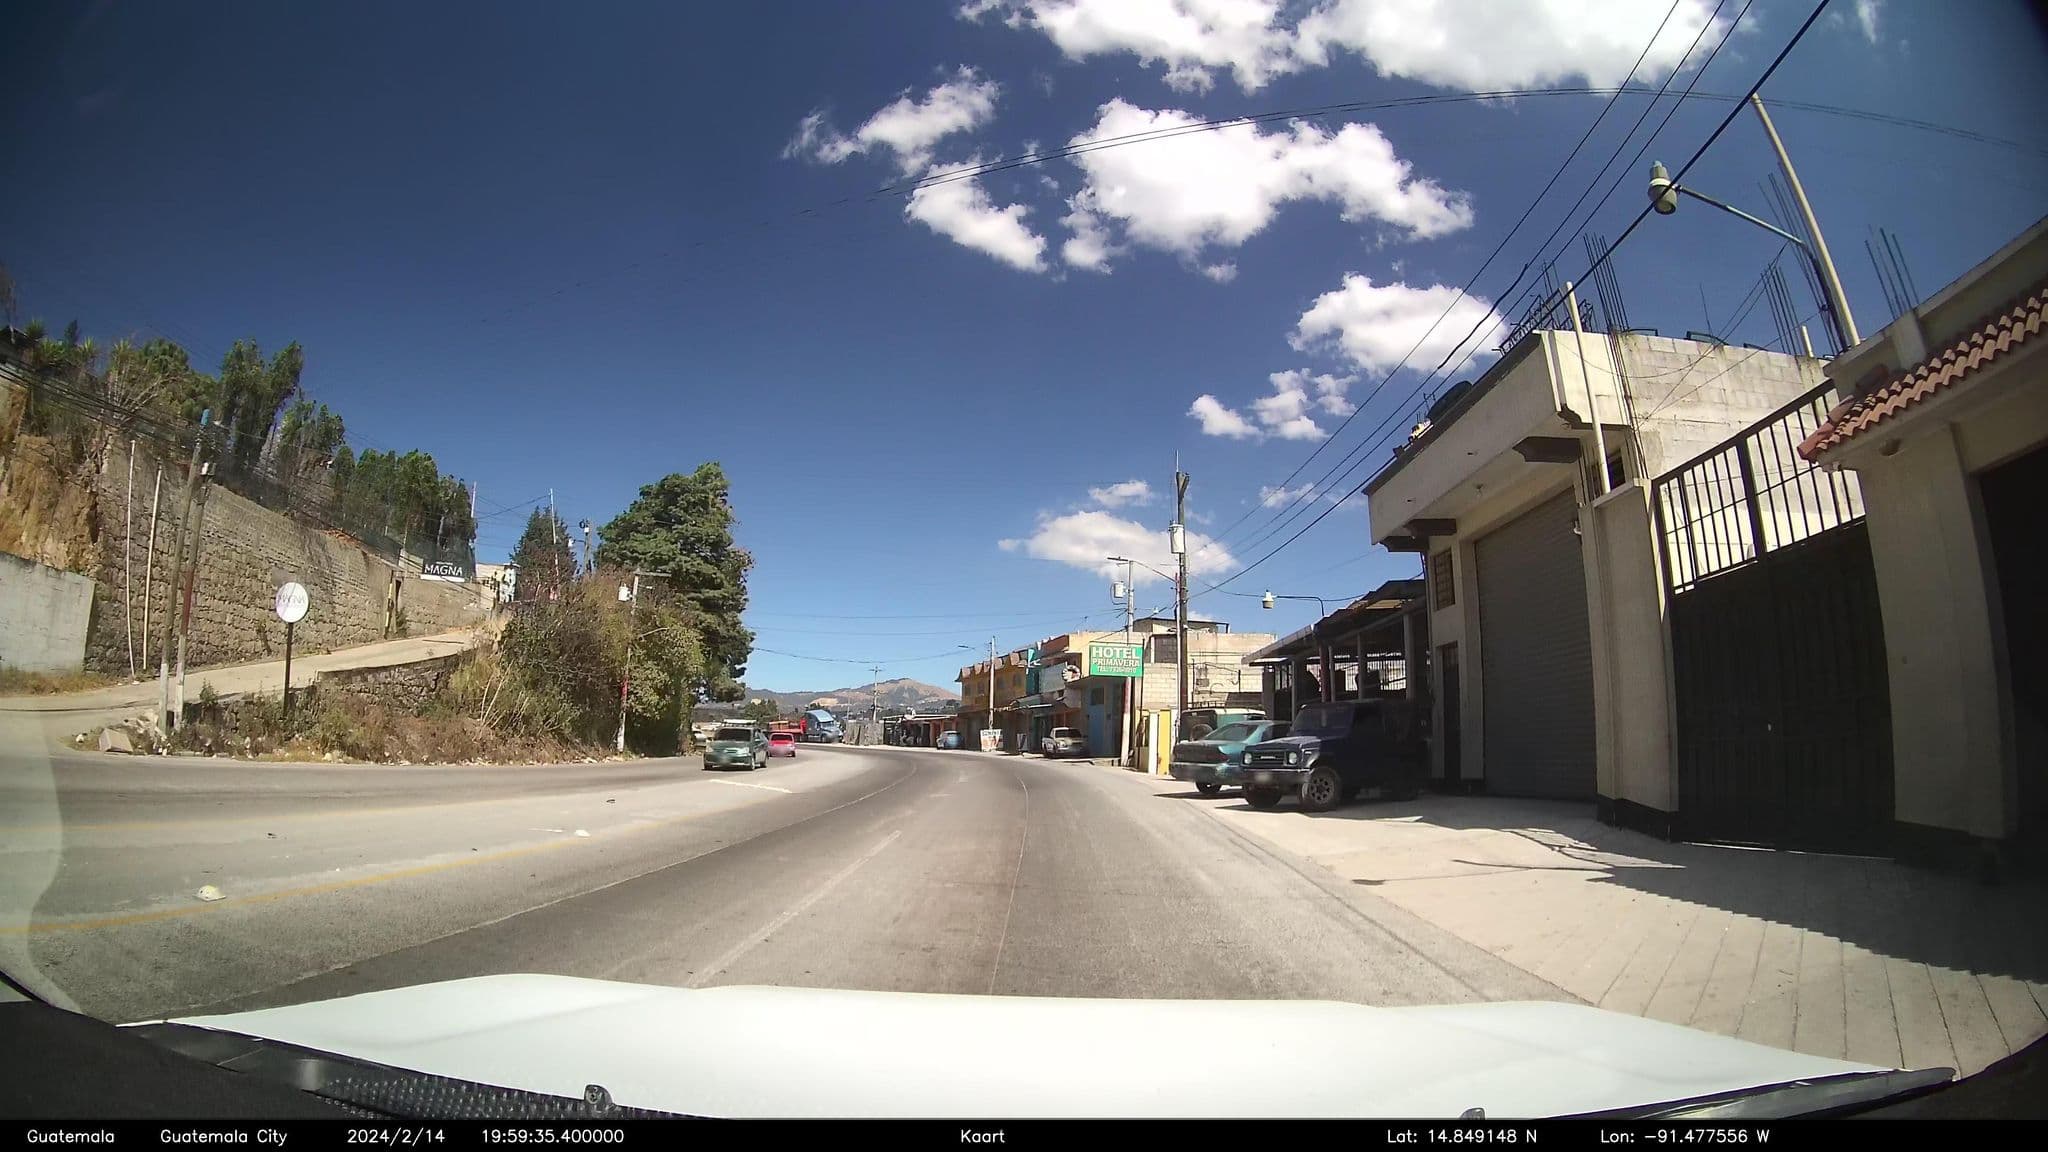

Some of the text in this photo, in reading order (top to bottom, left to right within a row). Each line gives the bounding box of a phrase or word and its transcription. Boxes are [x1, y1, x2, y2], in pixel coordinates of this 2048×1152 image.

[424, 563, 464, 577] MAGNA
[1092, 646, 1141, 660] HOTEL
[1092, 657, 1141, 667] PRIMAVERA
